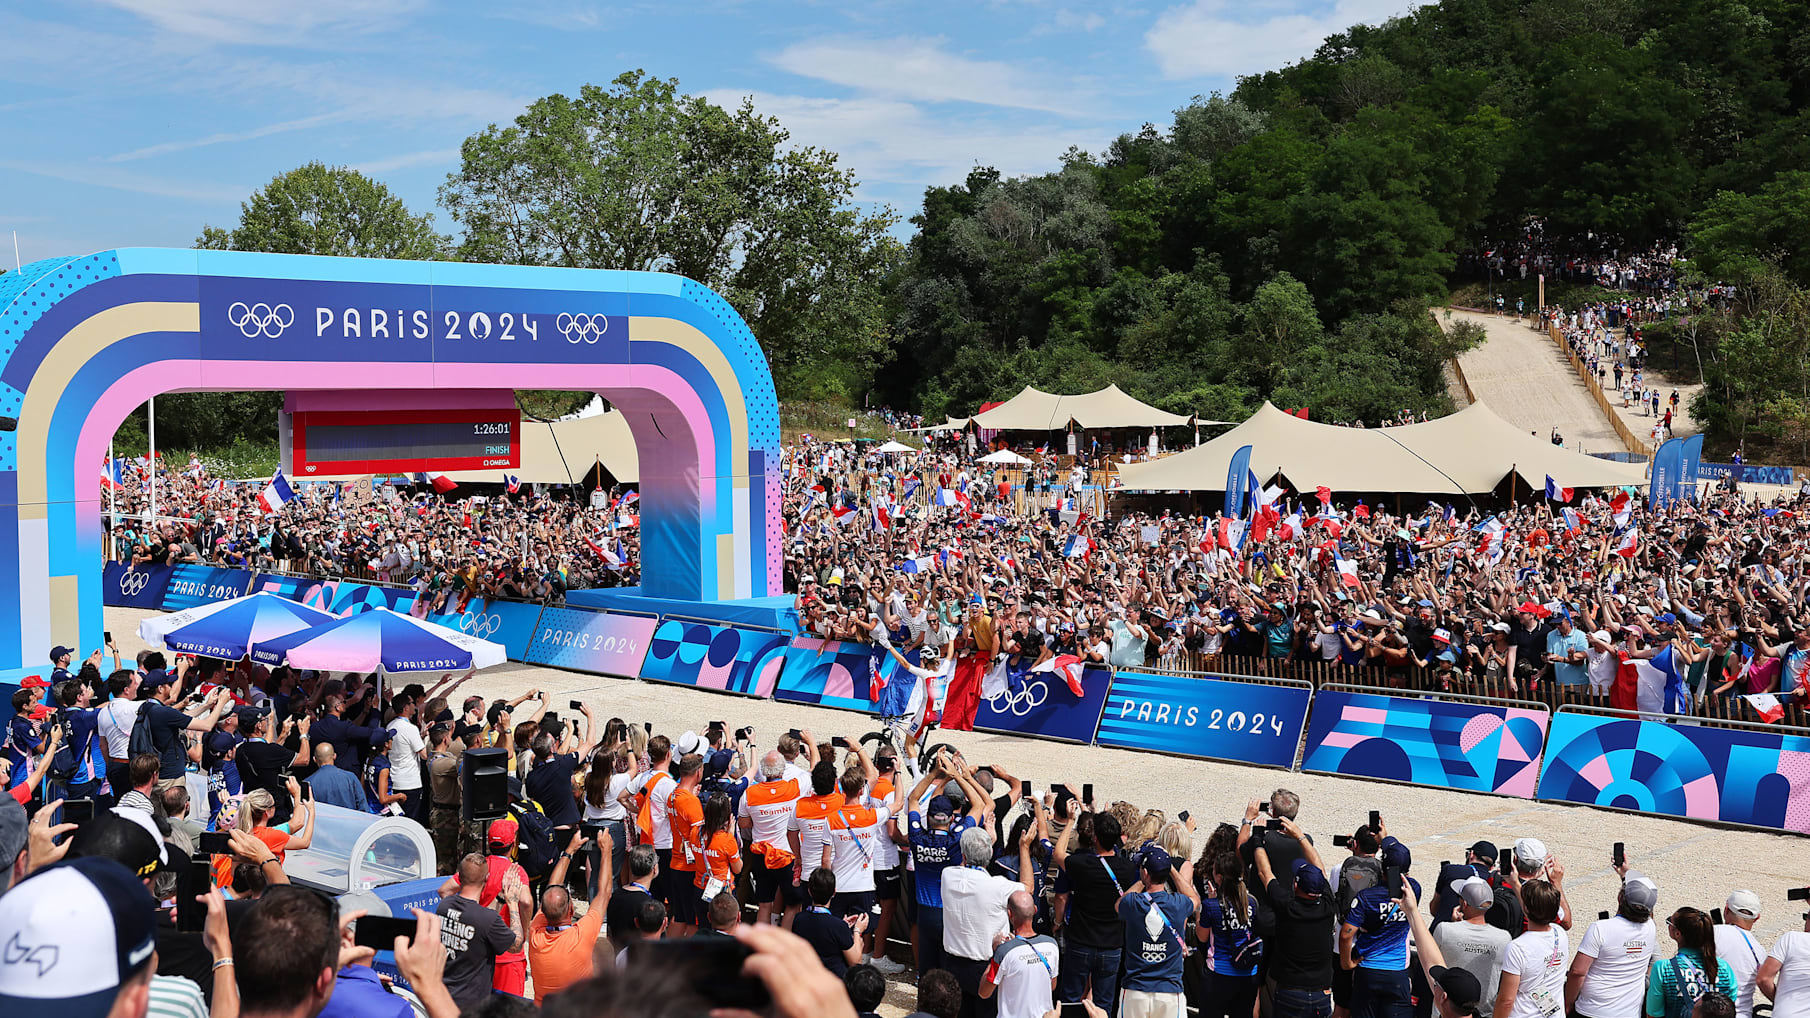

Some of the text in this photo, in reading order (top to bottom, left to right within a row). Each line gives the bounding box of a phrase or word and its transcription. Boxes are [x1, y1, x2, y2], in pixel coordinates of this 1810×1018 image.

[444, 311, 538, 341] 2024
[474, 423, 510, 434] 1:26:01
[485, 445, 510, 454] FINISH
[208, 584, 239, 600] 2024
[592, 635, 638, 656] 2024
[206, 646, 232, 657] 2024
[396, 659, 458, 670] PARIS 2024
[1207, 708, 1283, 737] 2024
[447, 908, 462, 921] THE
[1142, 941, 1168, 952] FRANCE
[1623, 940, 1647, 948] AUSTRIA
